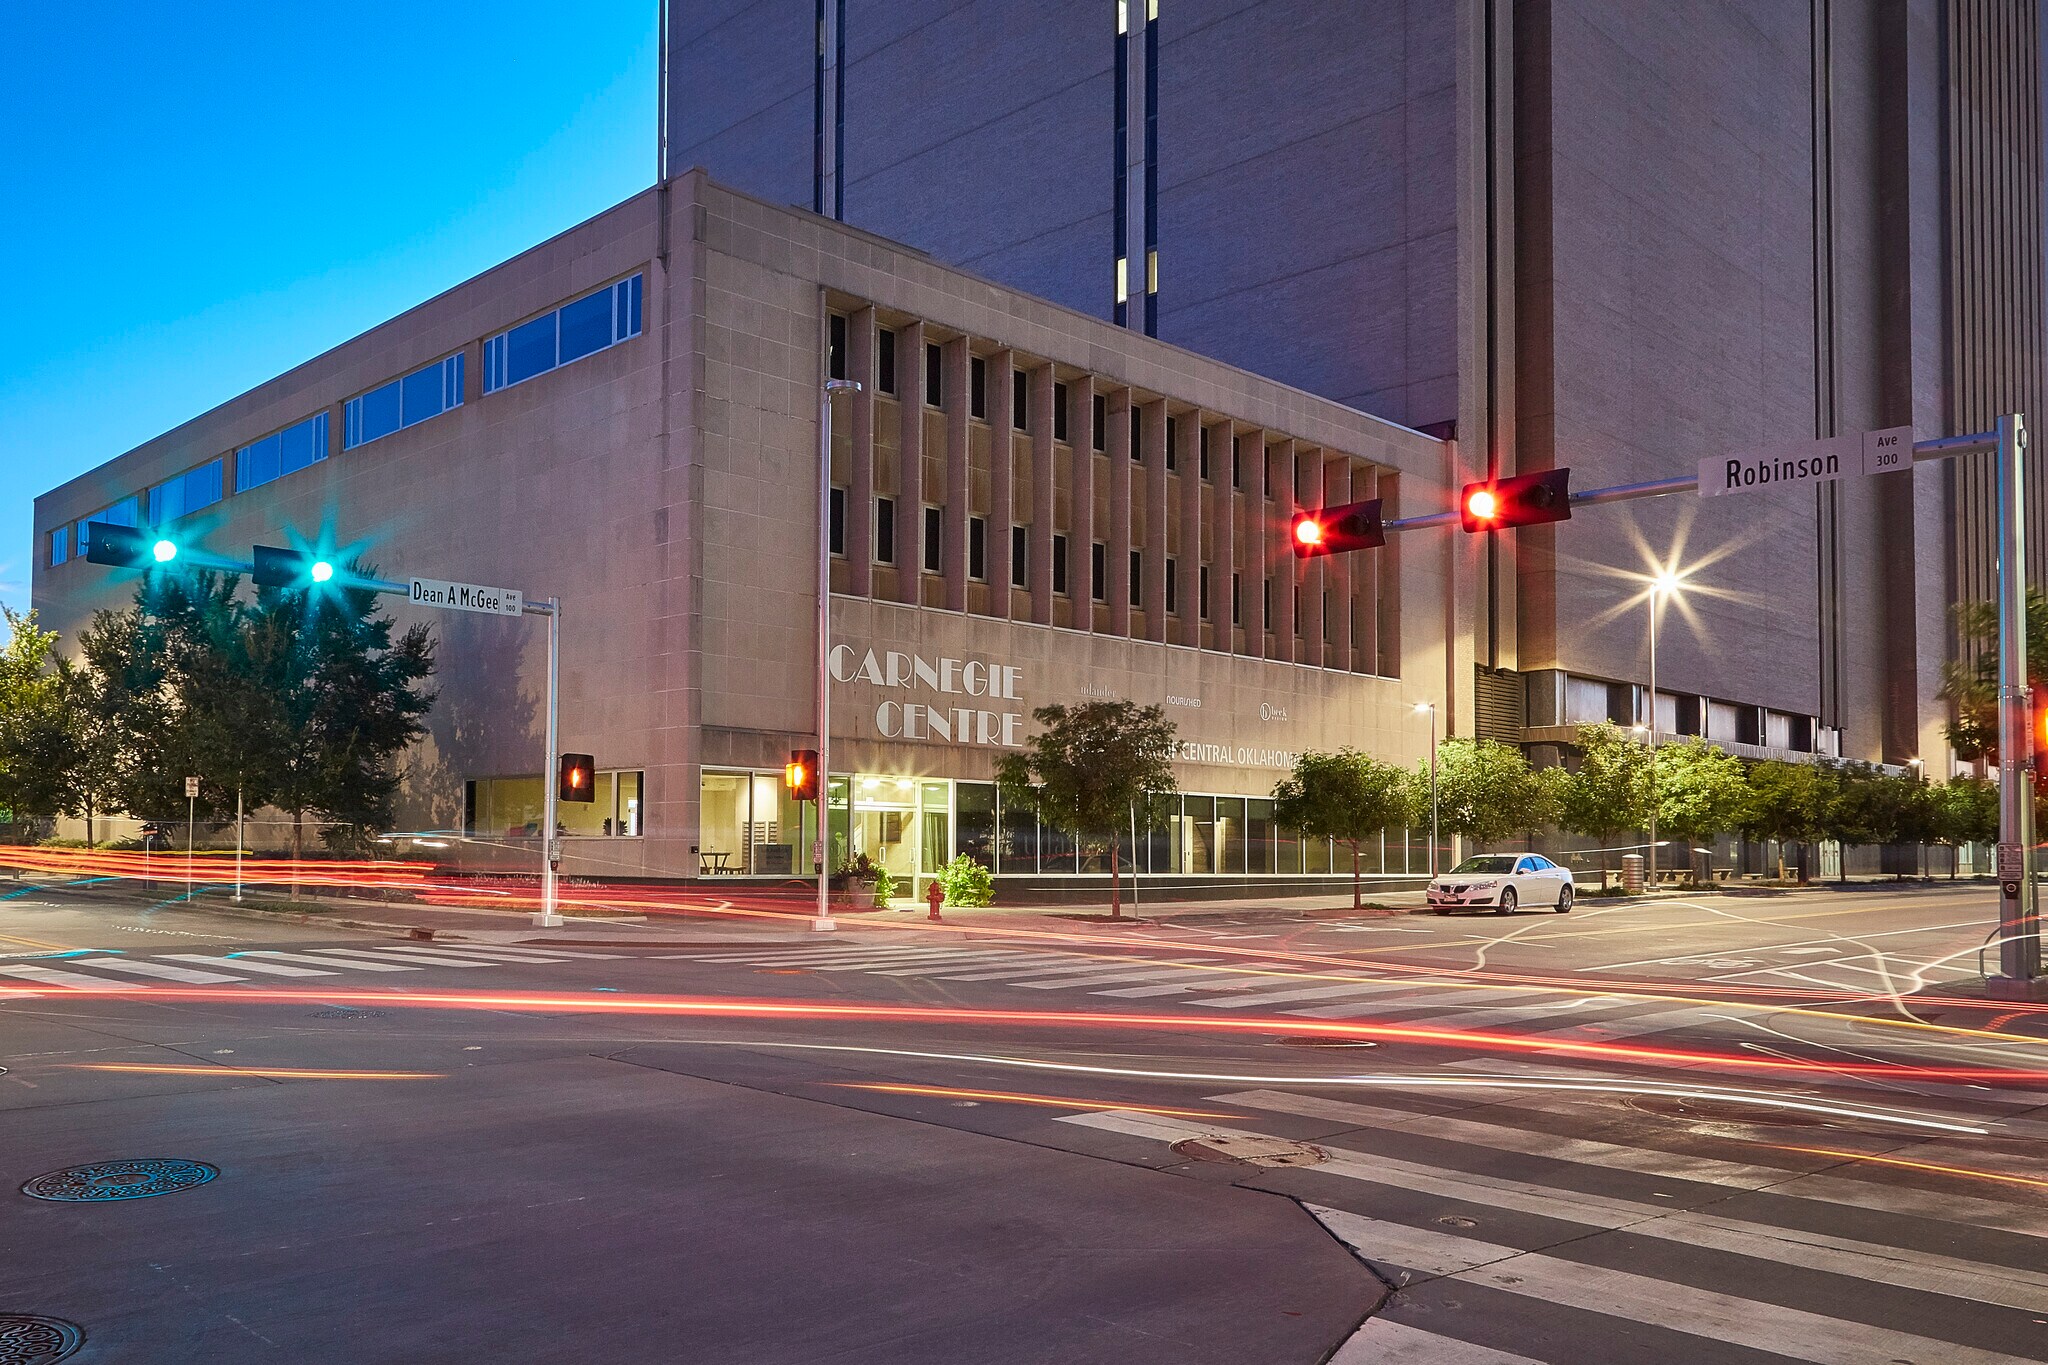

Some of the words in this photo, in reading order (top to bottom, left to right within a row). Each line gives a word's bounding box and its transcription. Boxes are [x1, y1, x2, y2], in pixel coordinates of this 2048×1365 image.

[1877, 435, 1898, 448] Ave
[1877, 453, 1898, 467] 300
[1726, 454, 1839, 488] Robinson
[413, 582, 443, 603] Dean
[447, 586, 456, 604] A
[460, 587, 498, 610] McGee
[505, 593, 516, 601] Ave
[829, 644, 1024, 700] CARNEGIE
[1166, 695, 1201, 708] NOURISHED
[876, 700, 1023, 747] CENTRE
[1182, 743, 1234, 764] CENTRAL
